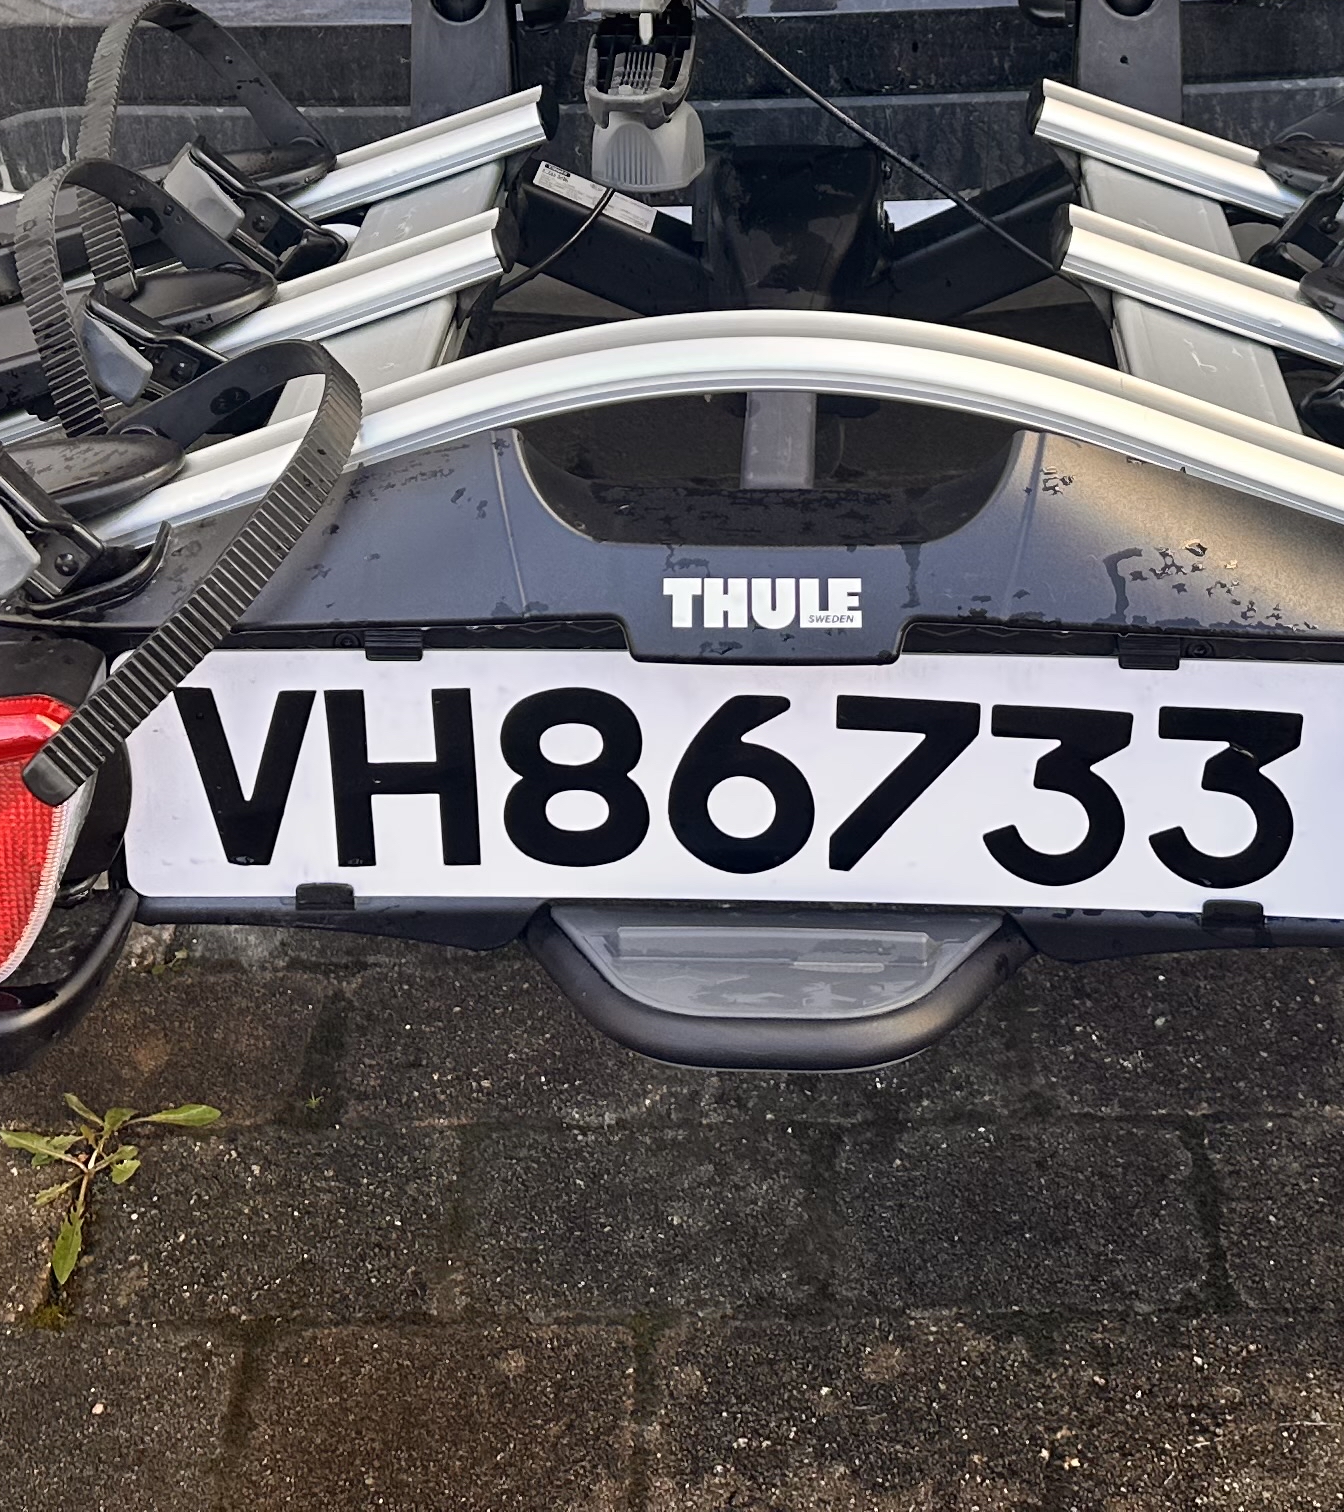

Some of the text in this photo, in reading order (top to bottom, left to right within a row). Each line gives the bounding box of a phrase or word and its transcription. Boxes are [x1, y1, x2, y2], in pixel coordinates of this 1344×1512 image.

[662, 577, 863, 630] THULE
[808, 614, 855, 624] SWEDEN
[174, 685, 1304, 889] VH86733
